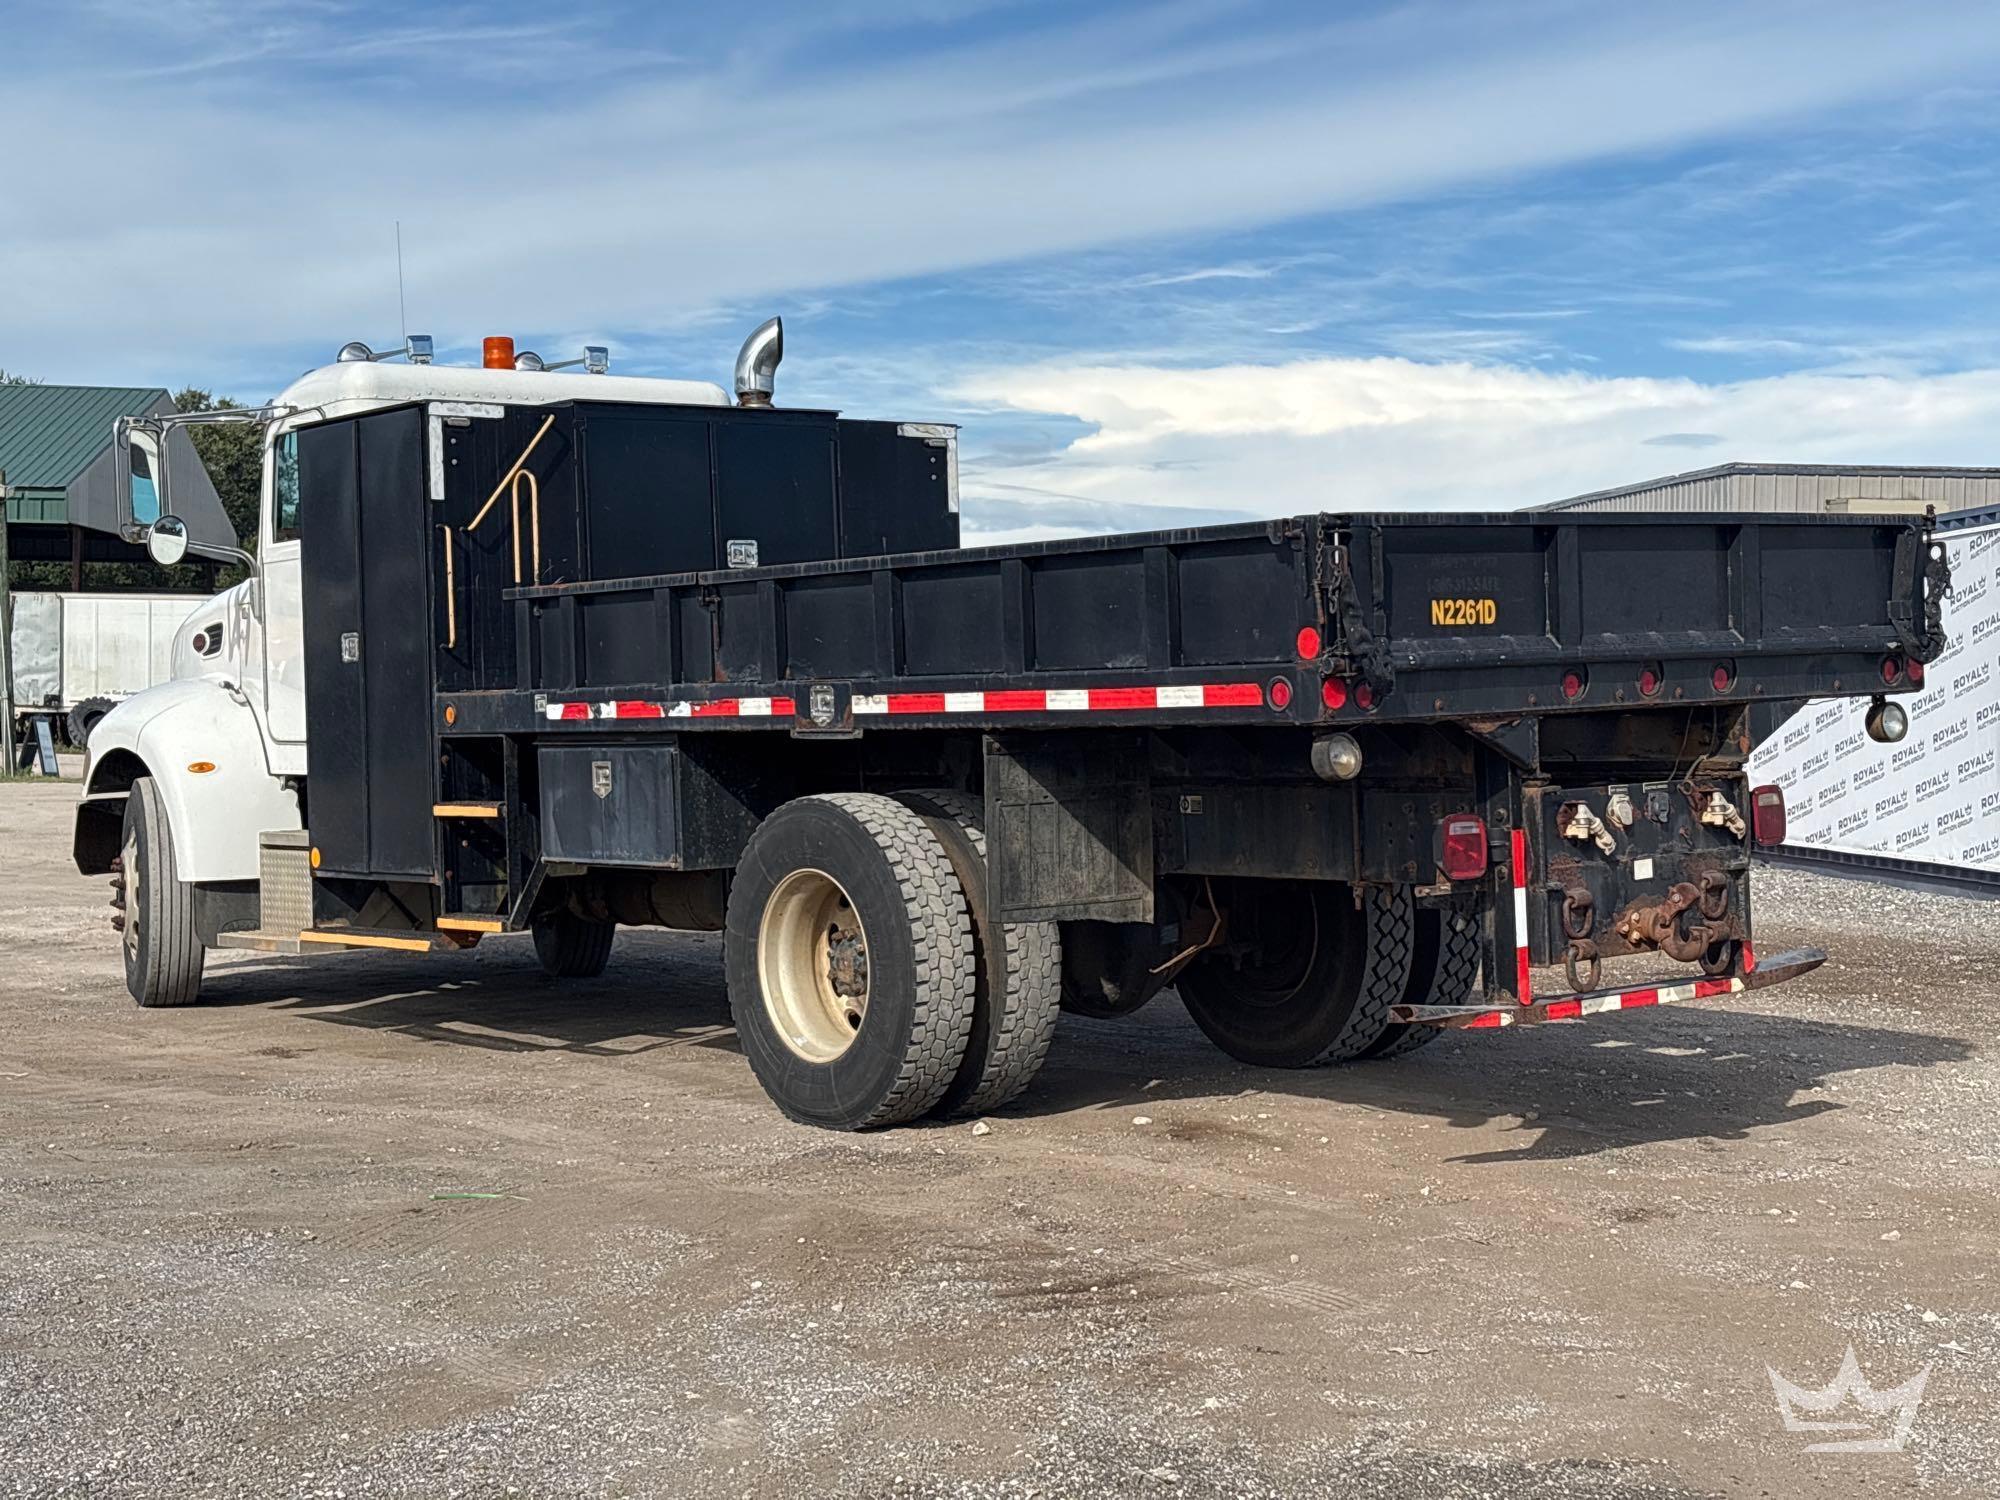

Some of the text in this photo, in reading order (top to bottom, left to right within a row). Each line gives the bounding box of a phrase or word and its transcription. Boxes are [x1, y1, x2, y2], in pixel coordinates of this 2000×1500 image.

[1950, 581, 1978, 607] ROYAL
[1431, 599, 1496, 625] N2261D
[1953, 667, 1981, 691] ROYAL
[1911, 691, 1938, 713] ROYAL
[1976, 701, 2000, 723] ROYA
[1816, 707, 1837, 726] ROYAL
[1784, 726, 1804, 745] ROYAL
[1932, 722, 1960, 745] ROYAL
[1753, 746, 1773, 762] ROYAL
[1835, 734, 1858, 754] ROYAL
[1802, 753, 1823, 772] ROYAL
[1892, 744, 1918, 765] ROYAL
[1958, 753, 1986, 775] ROYAL
[1853, 764, 1878, 784] ROYAL
[1818, 782, 1840, 801] ROYAL
[1915, 774, 1942, 795] ROYAL
[1787, 800, 1807, 816] ROYAL
[1876, 794, 1901, 813] ROYAL
[1981, 792, 2000, 809] ROY
[1838, 812, 1861, 830] ROYAL
[1937, 808, 1965, 828] ROYAL
[1896, 826, 1921, 845] ROYAL
[1963, 840, 1991, 860] ROYAL
